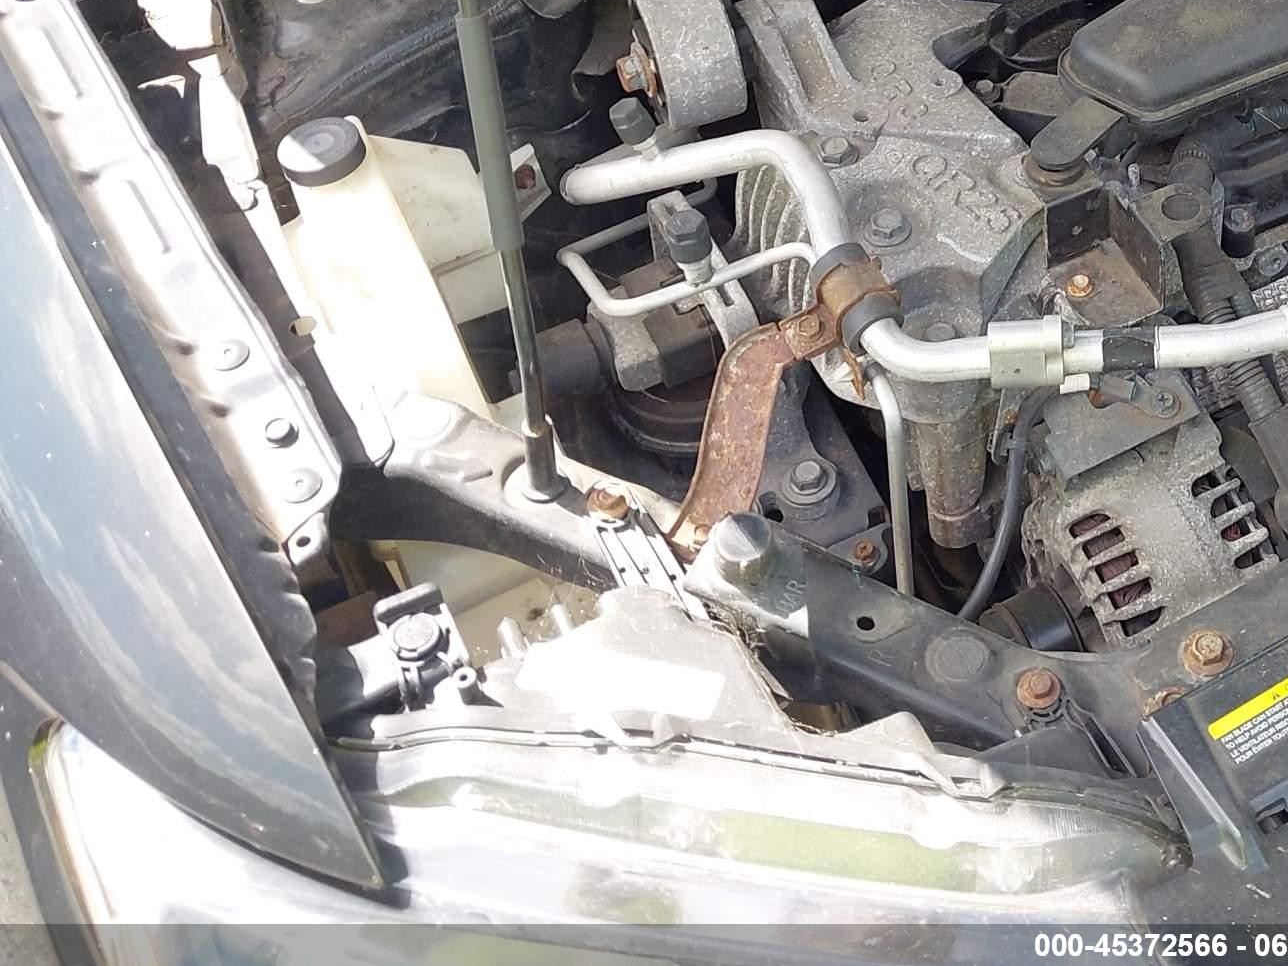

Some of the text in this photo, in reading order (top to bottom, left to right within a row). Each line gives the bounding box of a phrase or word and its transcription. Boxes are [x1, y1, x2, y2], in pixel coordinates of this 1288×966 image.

[1221, 732, 1234, 744] FAN
[1233, 721, 1253, 736] BLADE
[1252, 712, 1267, 725] CAN
[1264, 702, 1284, 716] START
[1225, 741, 1235, 750] TO
[1233, 731, 1250, 745] HELP
[1250, 721, 1269, 736] AVOID
[1230, 748, 1240, 758] LE
[1238, 727, 1276, 752] VENTILATEUR
[1234, 750, 1254, 764] POUR
